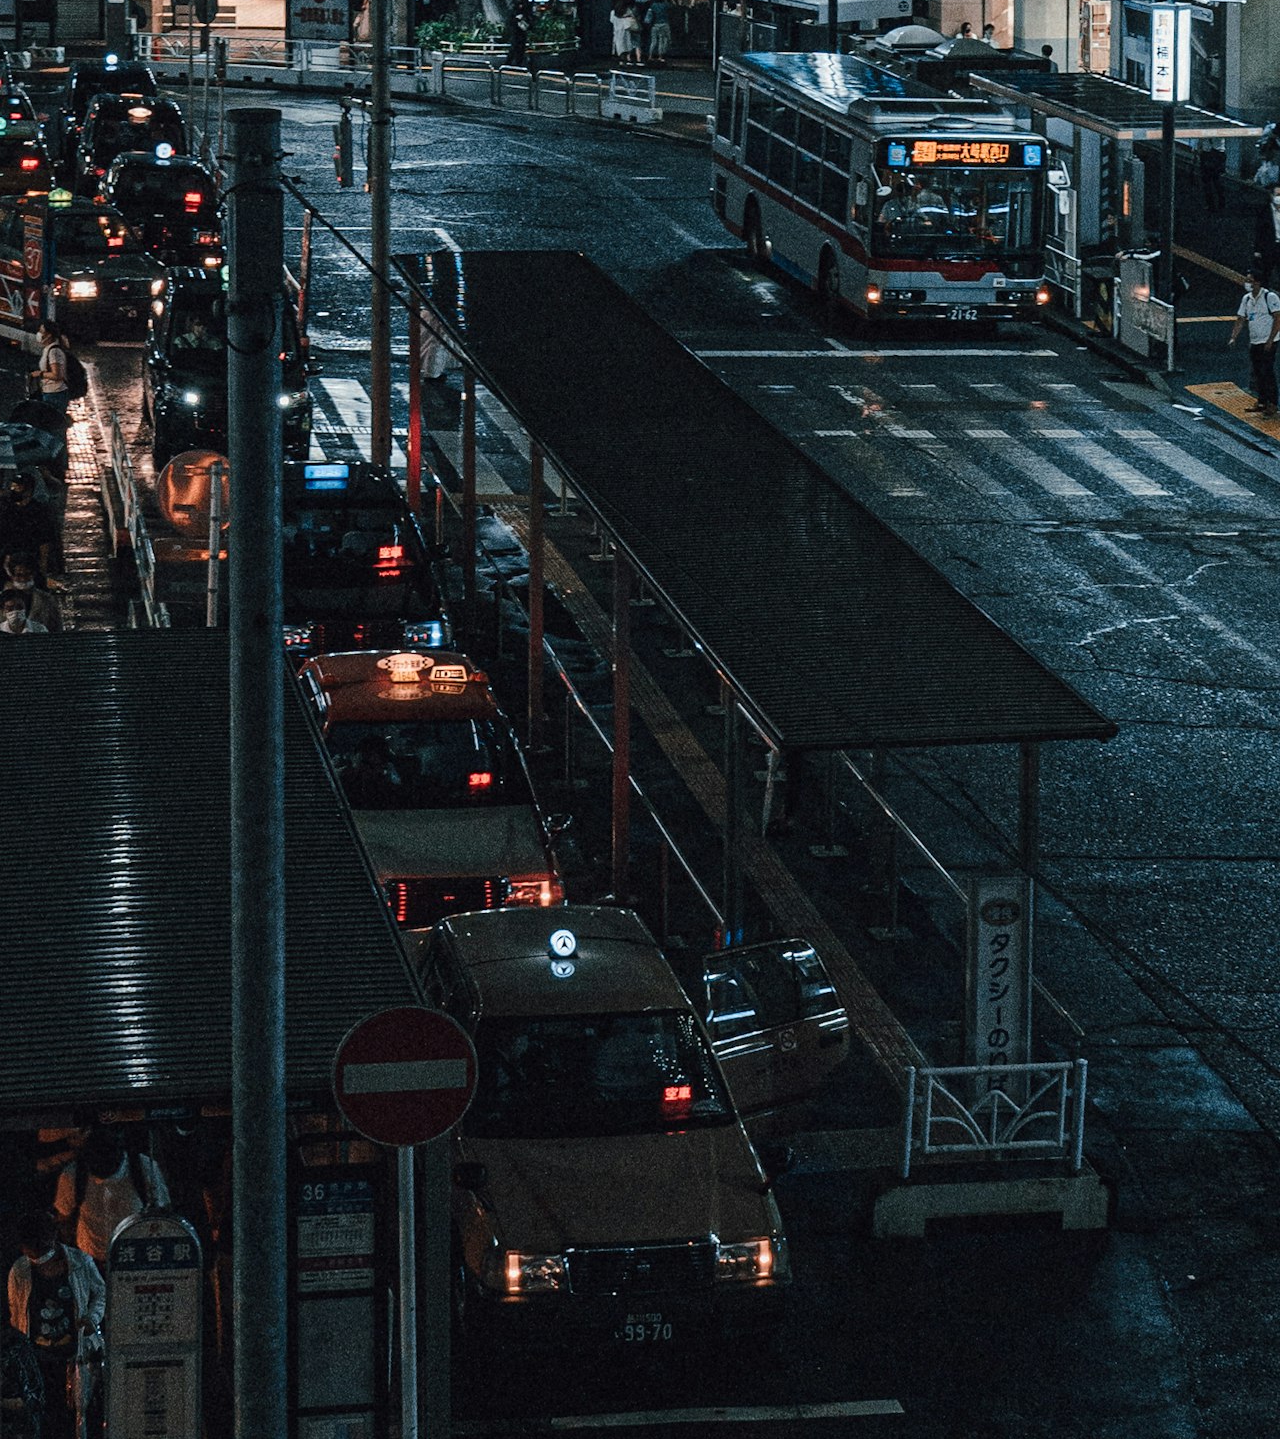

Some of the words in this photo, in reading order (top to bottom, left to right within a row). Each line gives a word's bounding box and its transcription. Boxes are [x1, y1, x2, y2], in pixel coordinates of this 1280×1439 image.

[303, 1183, 324, 1201] 36
[118, 1243, 191, 1263] 渋谷駅
[625, 1324, 672, 1341] 99-70
